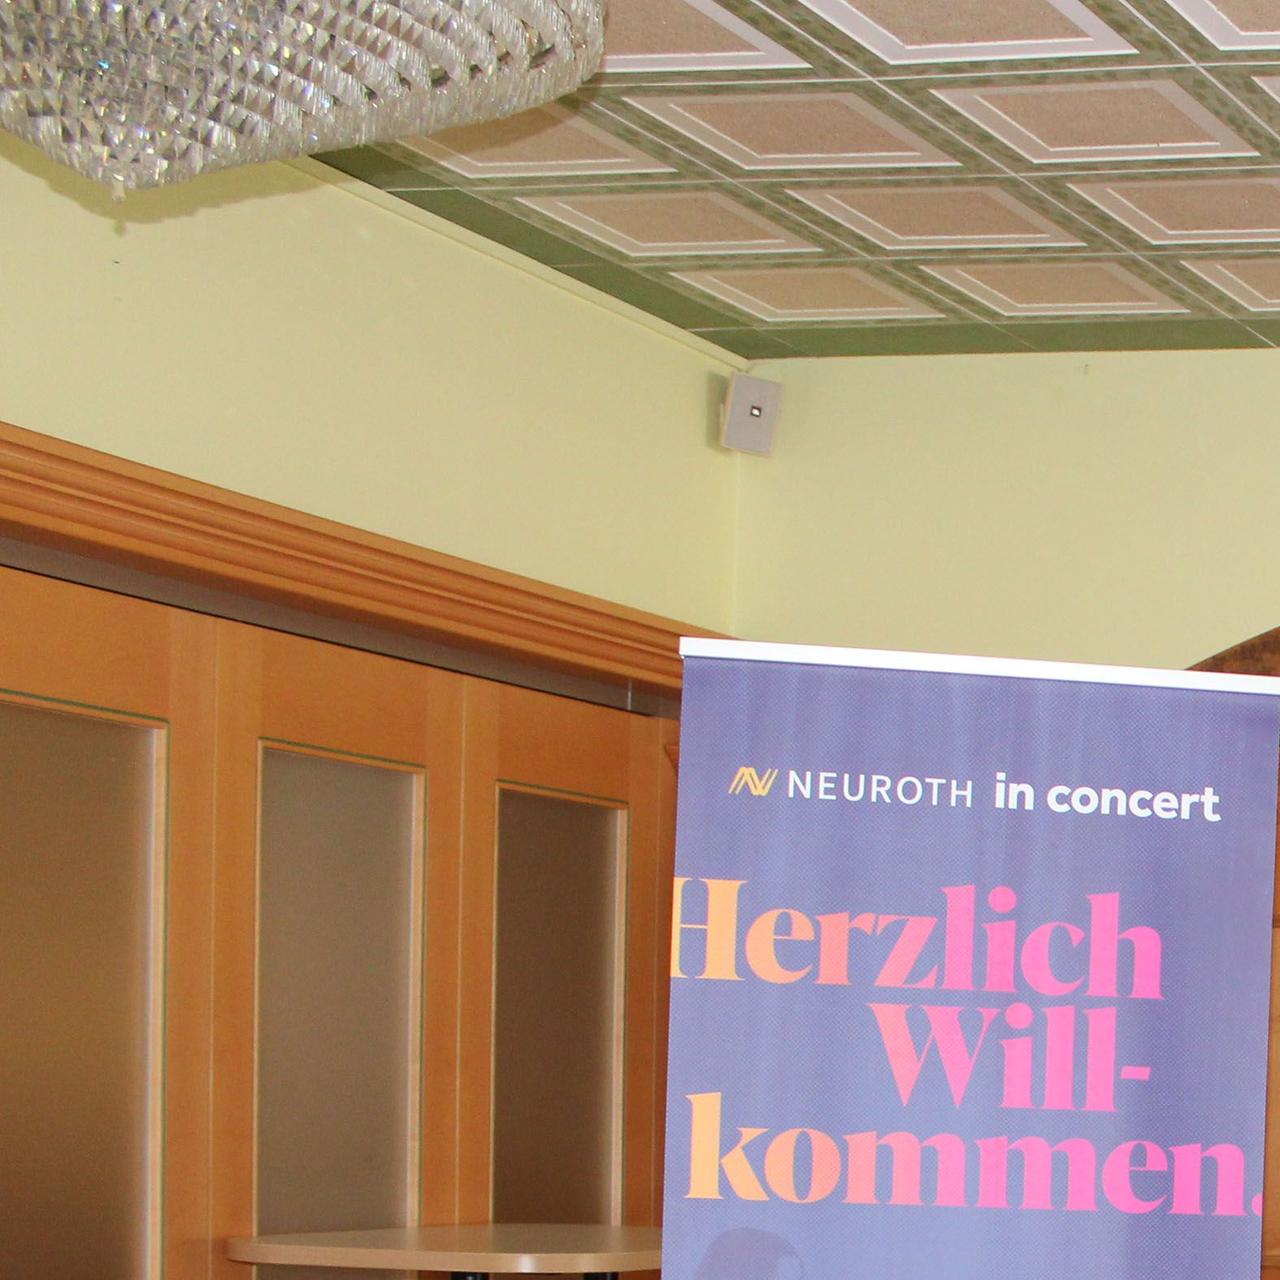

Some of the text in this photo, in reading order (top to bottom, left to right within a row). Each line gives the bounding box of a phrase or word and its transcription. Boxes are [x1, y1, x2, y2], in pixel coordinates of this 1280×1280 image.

[787, 769, 1222, 822] NEUROTH in concert
[670, 876, 1165, 1000] Herzlich
[866, 1001, 1152, 1112] Will-
